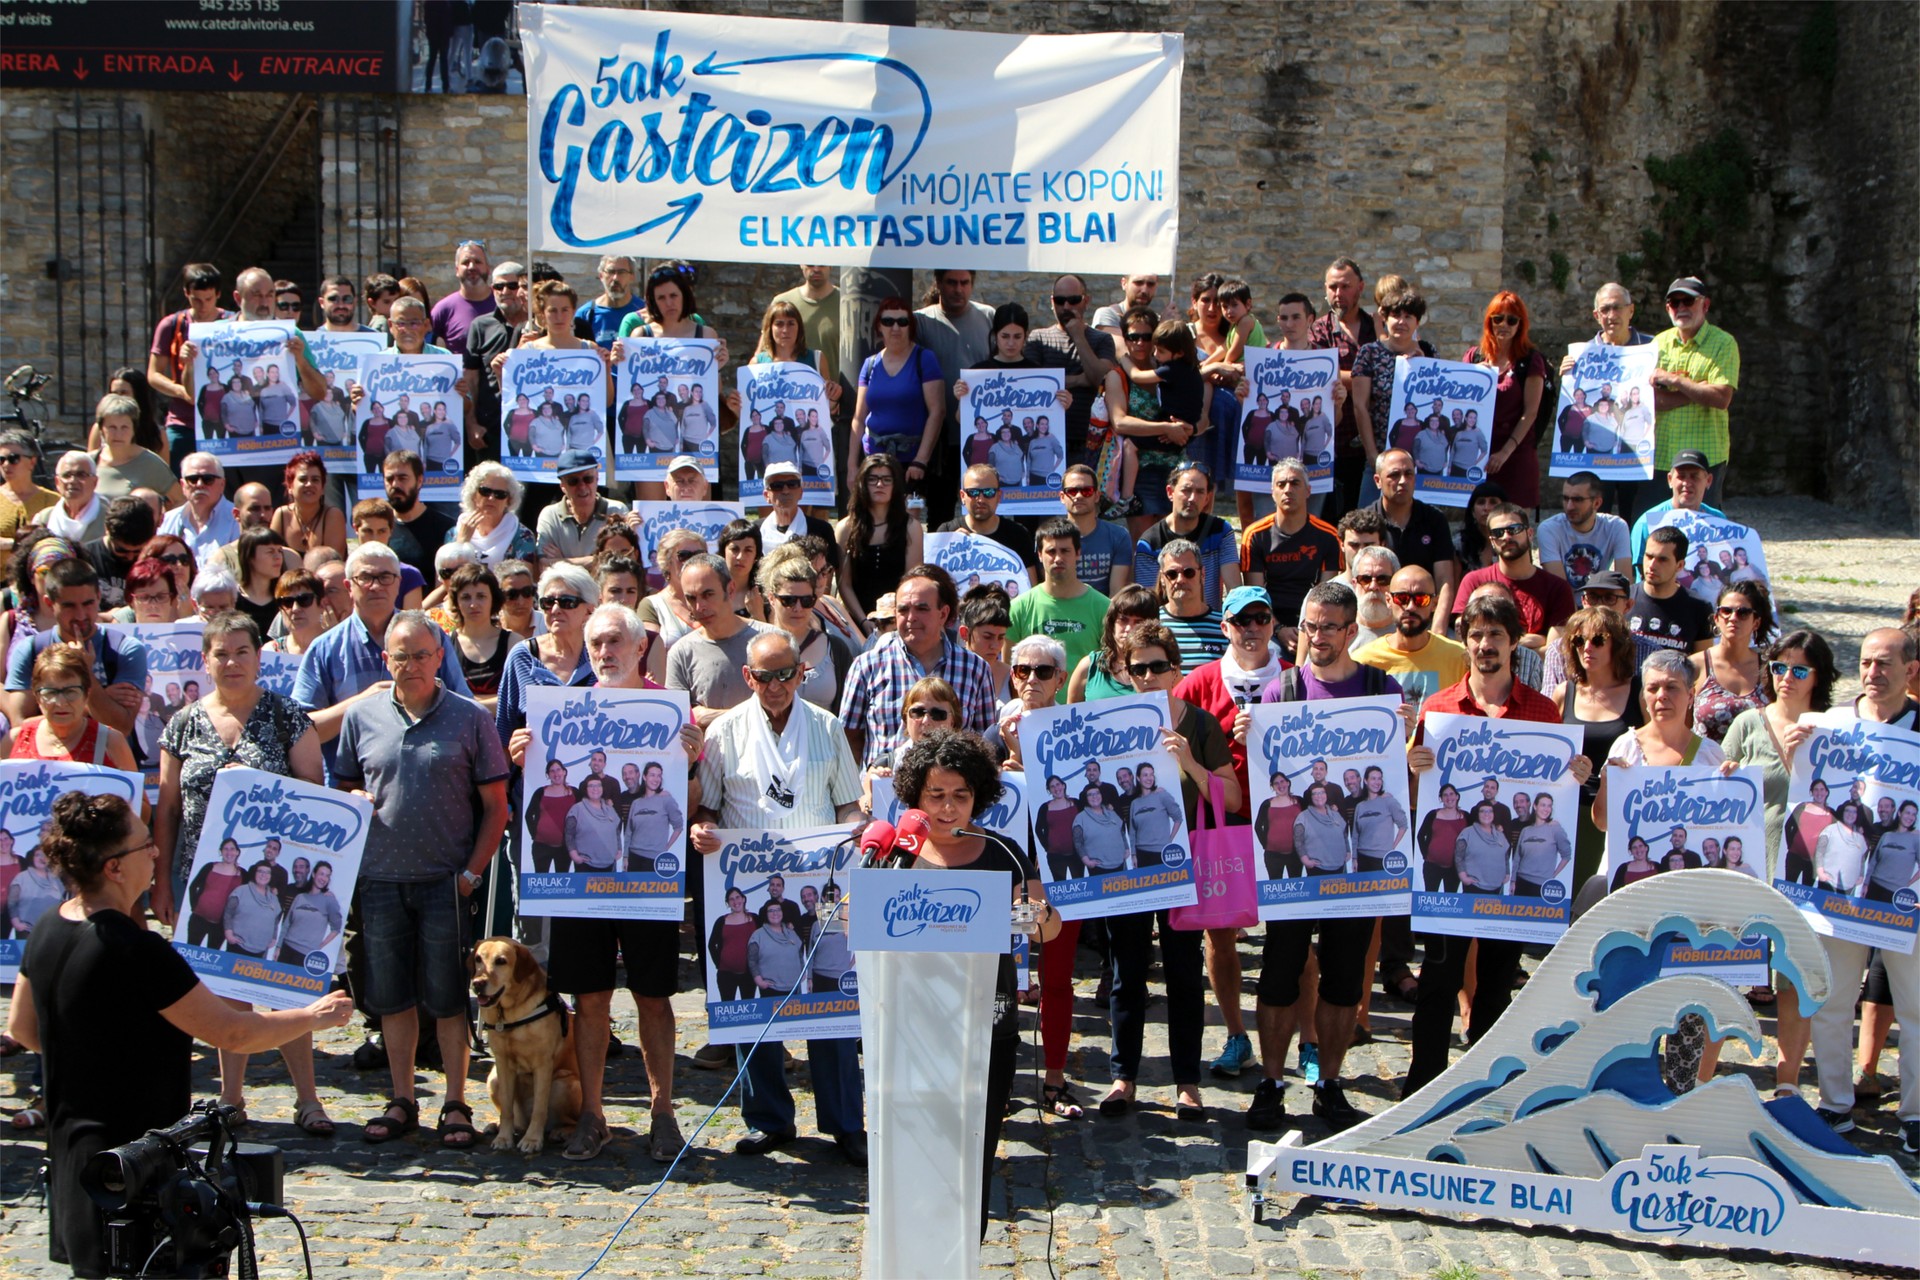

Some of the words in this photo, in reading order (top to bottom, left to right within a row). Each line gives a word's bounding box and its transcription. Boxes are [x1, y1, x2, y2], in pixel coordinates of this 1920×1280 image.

[19, 12, 53, 26] visits
[228, 0, 251, 11] 255
[257, 1, 280, 11] 135
[165, 18, 315, 31] www.catedralvitoria.eus
[104, 54, 215, 74] ENTRADA
[259, 56, 383, 76] ENTRANCE
[593, 28, 686, 109] 5ak
[539, 83, 896, 240] Gasteizen
[1043, 161, 1163, 202] KOPÓN!
[739, 212, 1026, 249] ELKARTASUNEZ
[1038, 212, 1117, 244] BLAI
[512, 364, 594, 391] Gasteizen
[628, 352, 706, 381] Gasteizen
[1253, 362, 1328, 392] Gasteizen
[367, 369, 451, 399] Gasteizen
[746, 377, 820, 407] Gasteizen
[1403, 371, 1484, 402] Gasteizen
[970, 384, 1052, 414] Gasteizen
[562, 691, 598, 719] 5ak
[1281, 704, 1314, 734] 5ak
[541, 709, 671, 758] Gasteizen
[1052, 707, 1084, 737] 5ak
[1457, 721, 1493, 746] 5ak
[1829, 722, 1865, 747] 5ak
[1036, 725, 1157, 774] Gasteizen
[1262, 722, 1388, 770] Gasteizen
[1435, 736, 1565, 783] Gasteizen
[15, 765, 51, 791] 5ak
[248, 779, 285, 804] 5ak
[1643, 770, 1676, 798] 5ak
[222, 791, 349, 851] Gasteizen
[1622, 788, 1751, 833] Gasteizen
[740, 832, 775, 852] 5ak
[527, 877, 562, 887] IRAILAK
[565, 877, 571, 887] 7
[585, 882, 679, 894] MOBILIZAZIOA
[897, 883, 922, 903] 5ak
[1048, 883, 1081, 895] IRAILAK
[1082, 881, 1087, 891] 7
[1102, 869, 1189, 894] MOBILIZAZIOA
[1202, 880, 1227, 898] 50
[1263, 882, 1297, 893] IRAILAK
[1299, 881, 1305, 891] 7
[1319, 877, 1409, 895] MOBILIZAZIOA
[1777, 883, 1807, 899] IRAILAK
[1418, 895, 1452, 906] IRAILAK
[1453, 897, 1460, 906] 7
[1472, 903, 1565, 919] MOBILIZAZIOA
[883, 897, 974, 936] Gasteizen
[1823, 901, 1914, 929] MOBILIZAZIOA
[1671, 949, 1762, 963] MOBILIZAZIOA
[232, 964, 325, 993] MOBILIZAZIOA
[714, 1003, 749, 1016] IRAILAK
[752, 1003, 757, 1013] 7
[1646, 1155, 1692, 1185] 5ak
[1291, 1159, 1496, 1206] ELKARTASUNEZ
[1511, 1184, 1573, 1216] BLAI
[1611, 1170, 1773, 1237] Gasteizen
